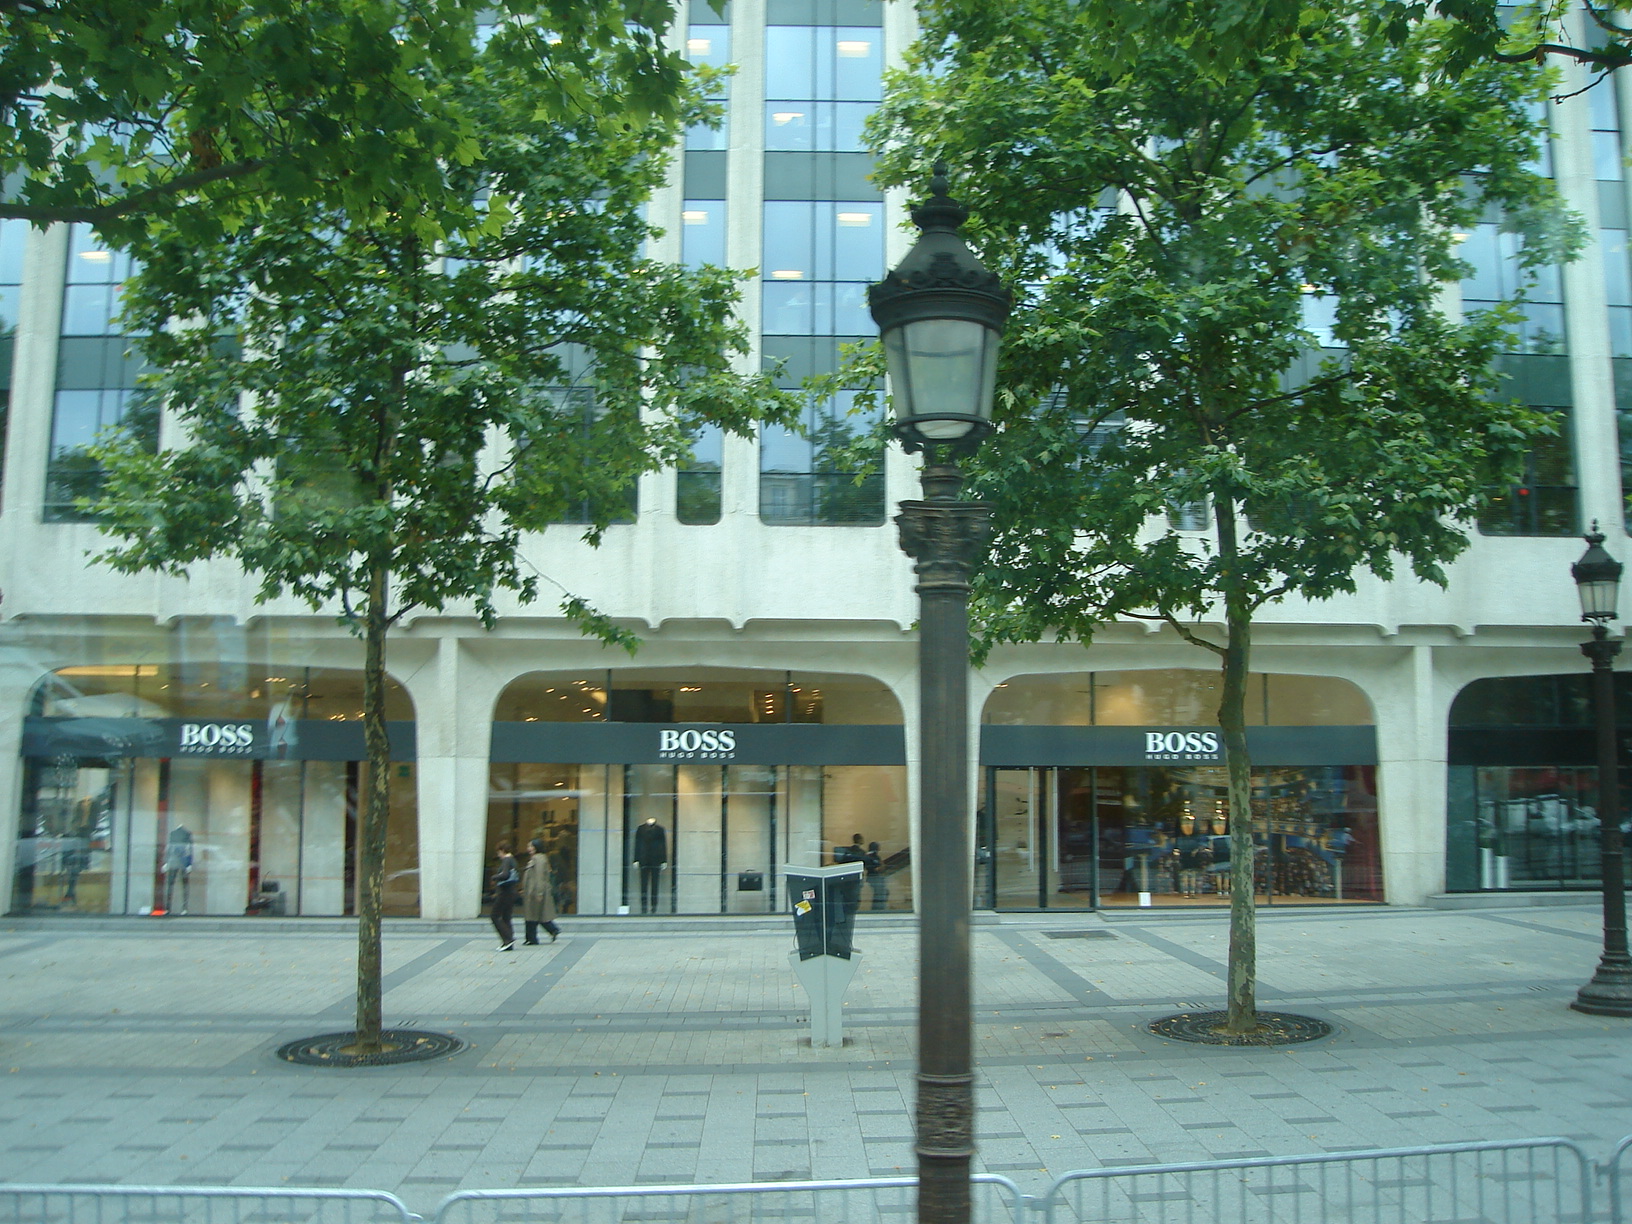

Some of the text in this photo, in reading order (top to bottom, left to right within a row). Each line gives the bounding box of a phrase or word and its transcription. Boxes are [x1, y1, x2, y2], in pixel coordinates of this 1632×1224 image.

[180, 723, 254, 746] BOSS
[659, 729, 736, 751] BOSS
[1145, 732, 1219, 752] BOSS
